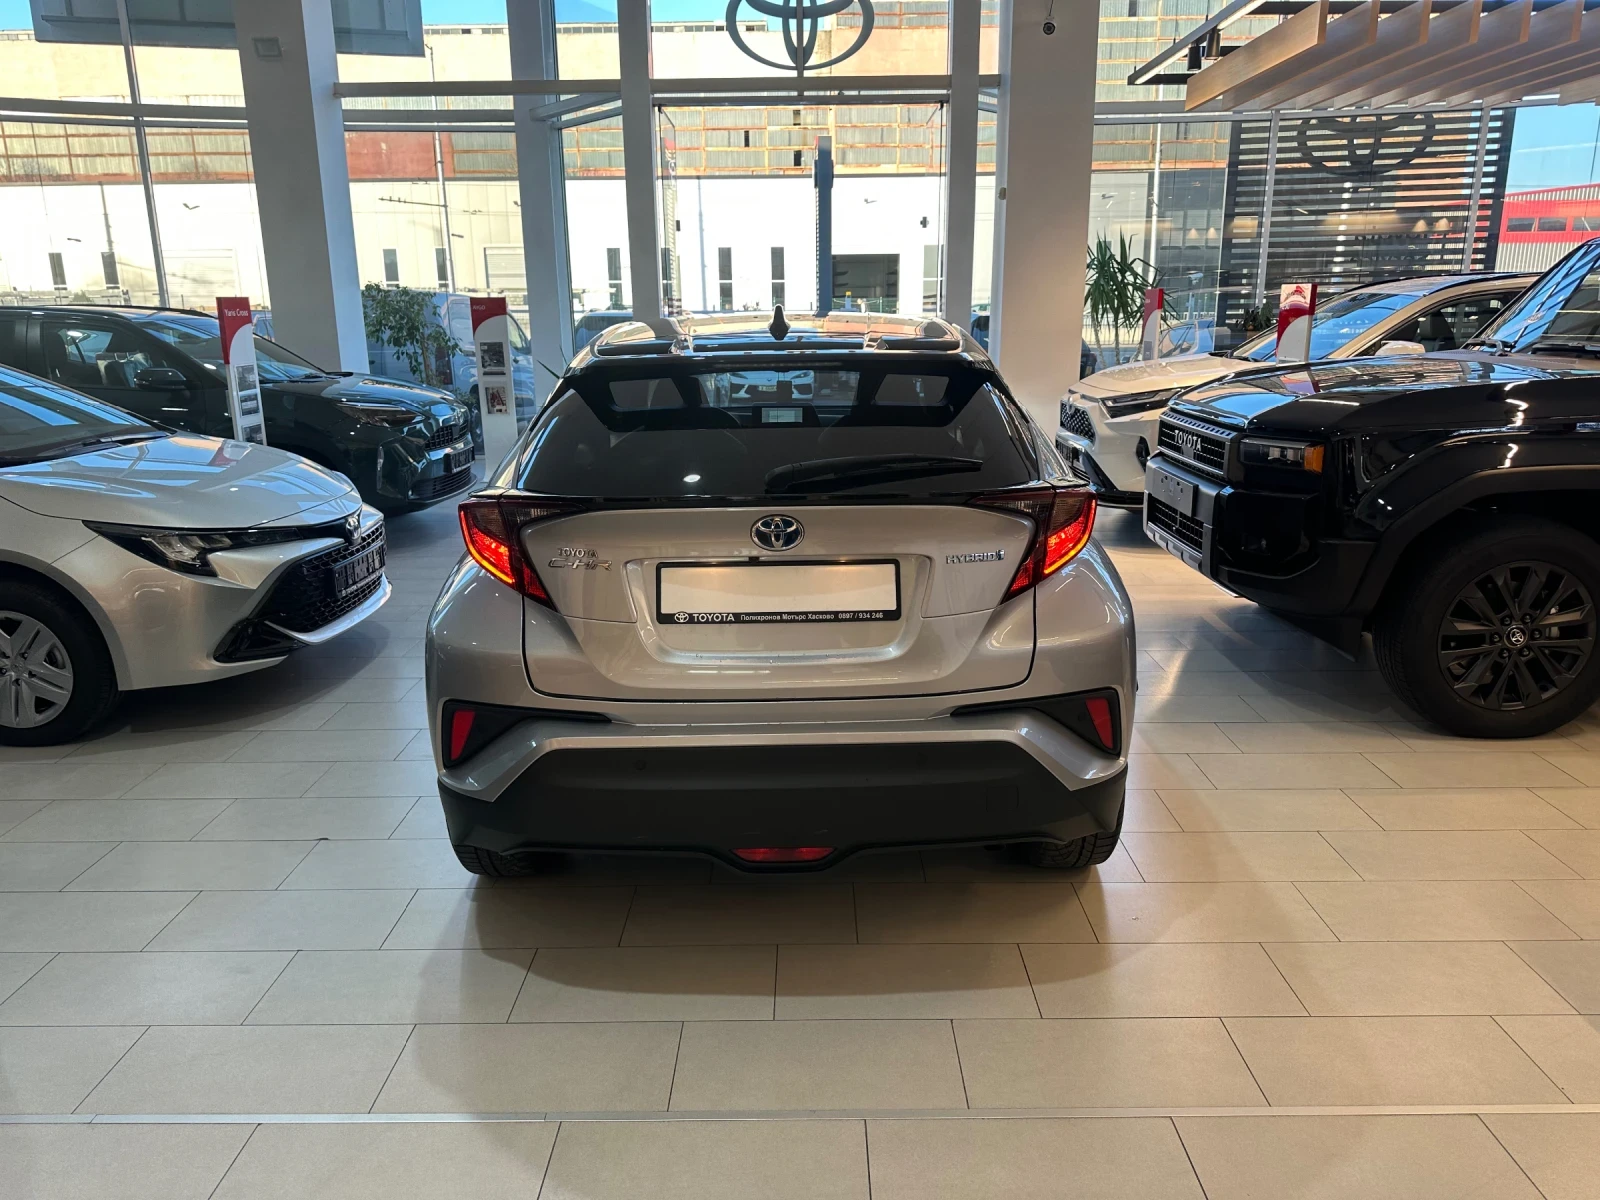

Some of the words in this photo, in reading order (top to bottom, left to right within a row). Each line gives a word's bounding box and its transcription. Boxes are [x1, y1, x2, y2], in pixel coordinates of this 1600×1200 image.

[224, 309, 236, 317] Yaris
[236, 309, 249, 317] Cross
[1174, 429, 1202, 452] TOYOTA
[557, 547, 599, 559] TOYOTA
[945, 552, 997, 565] HYBRID
[692, 613, 735, 622] TOYOTA
